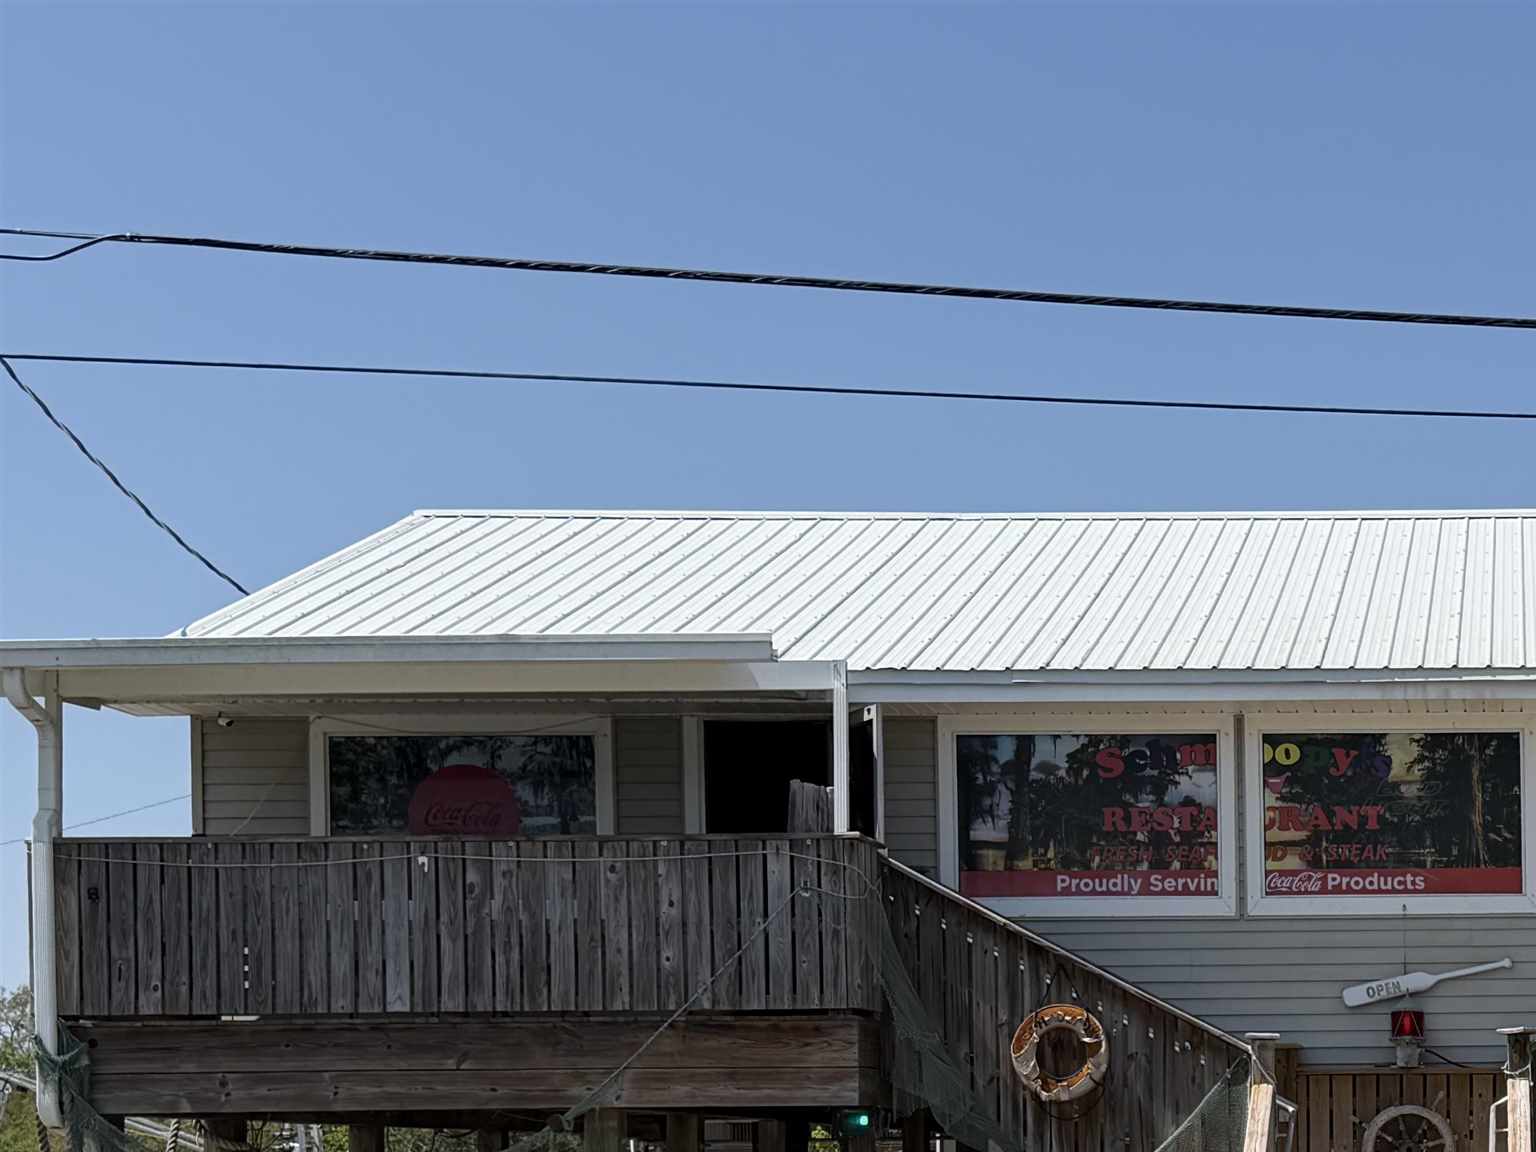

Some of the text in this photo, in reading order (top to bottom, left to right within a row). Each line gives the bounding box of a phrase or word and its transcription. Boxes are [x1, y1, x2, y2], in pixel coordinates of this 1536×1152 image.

[1326, 843, 1391, 864] STEAK
[1056, 872, 1425, 895] Proudly Servin Coca-Cola Products
[1366, 980, 1402, 999] OPEN
